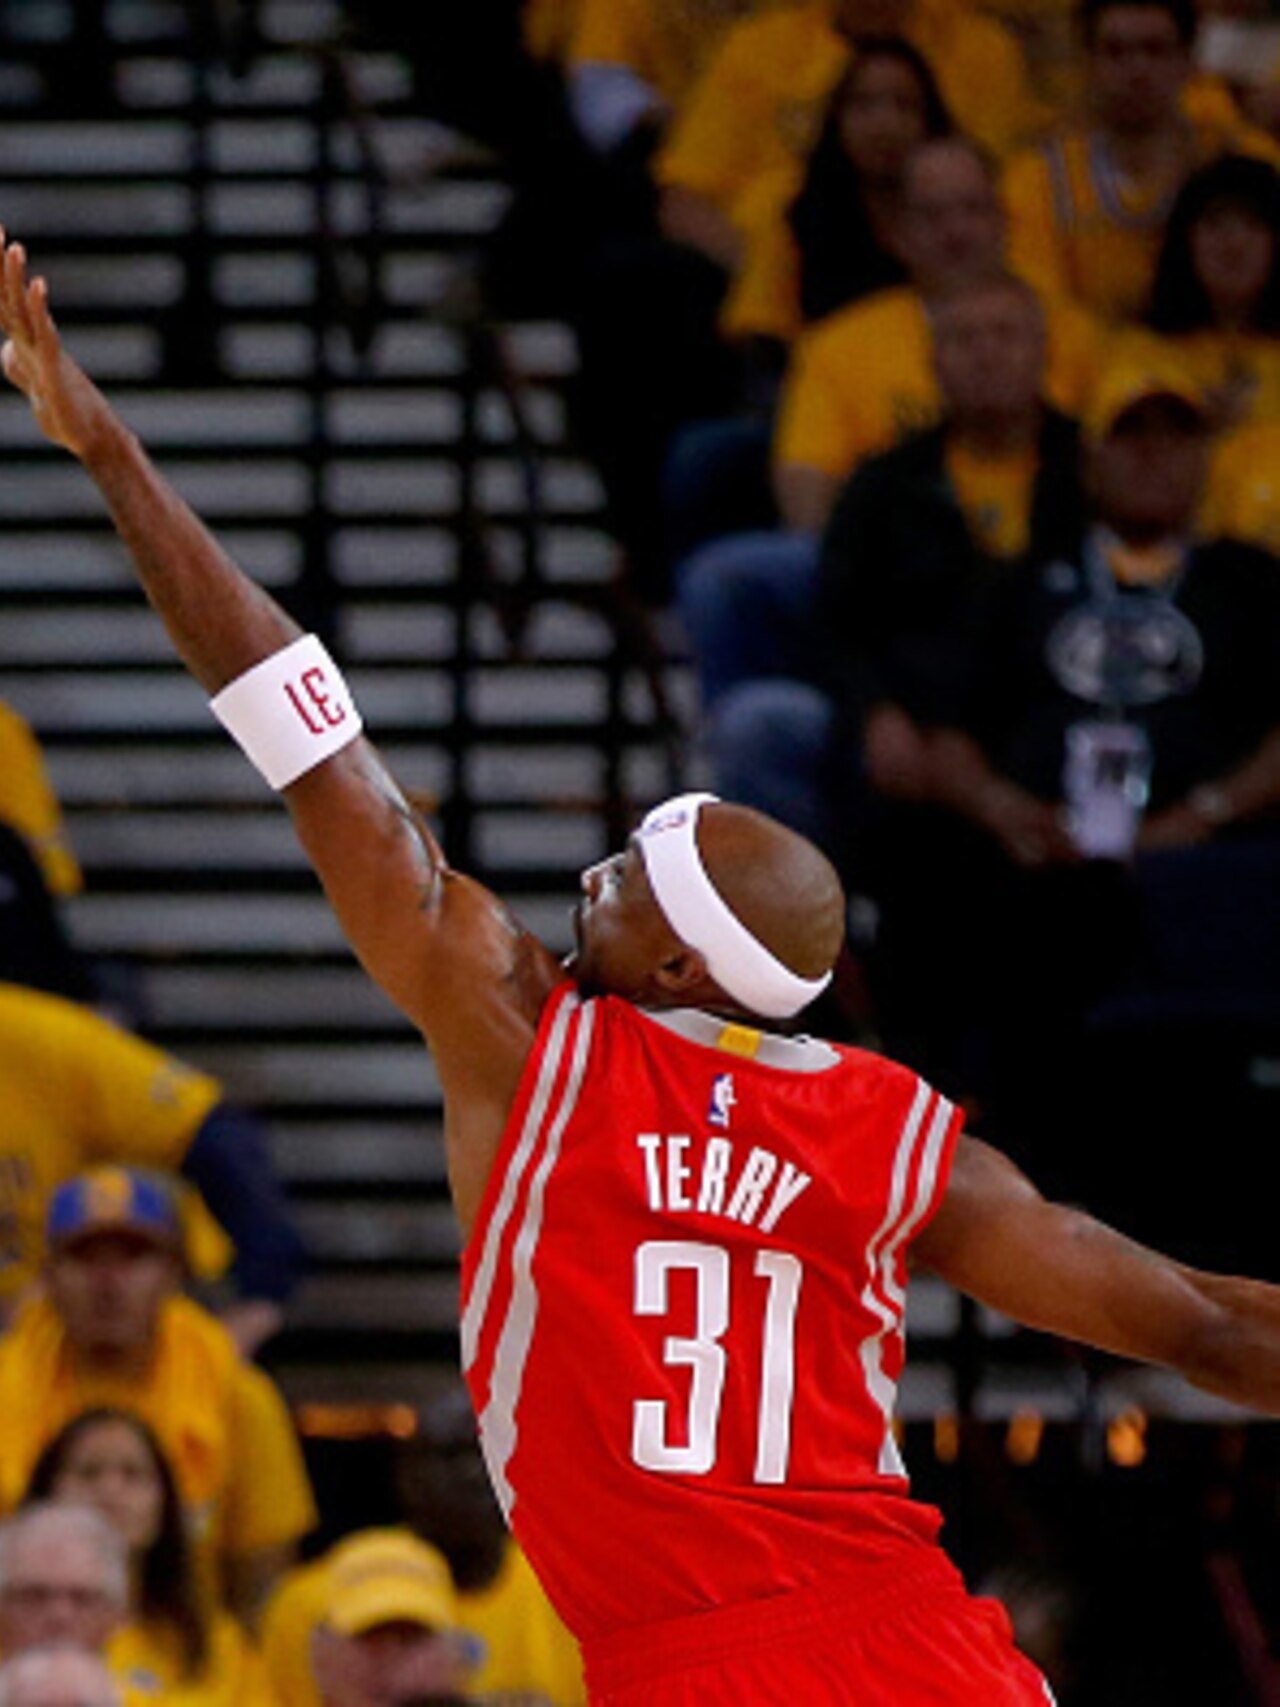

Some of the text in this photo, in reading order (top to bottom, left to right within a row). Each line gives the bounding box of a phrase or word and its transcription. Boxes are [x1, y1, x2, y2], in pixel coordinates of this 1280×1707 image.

[284, 666, 346, 734] 31
[637, 1133, 811, 1233] TERRY
[632, 1240, 803, 1484] 31
